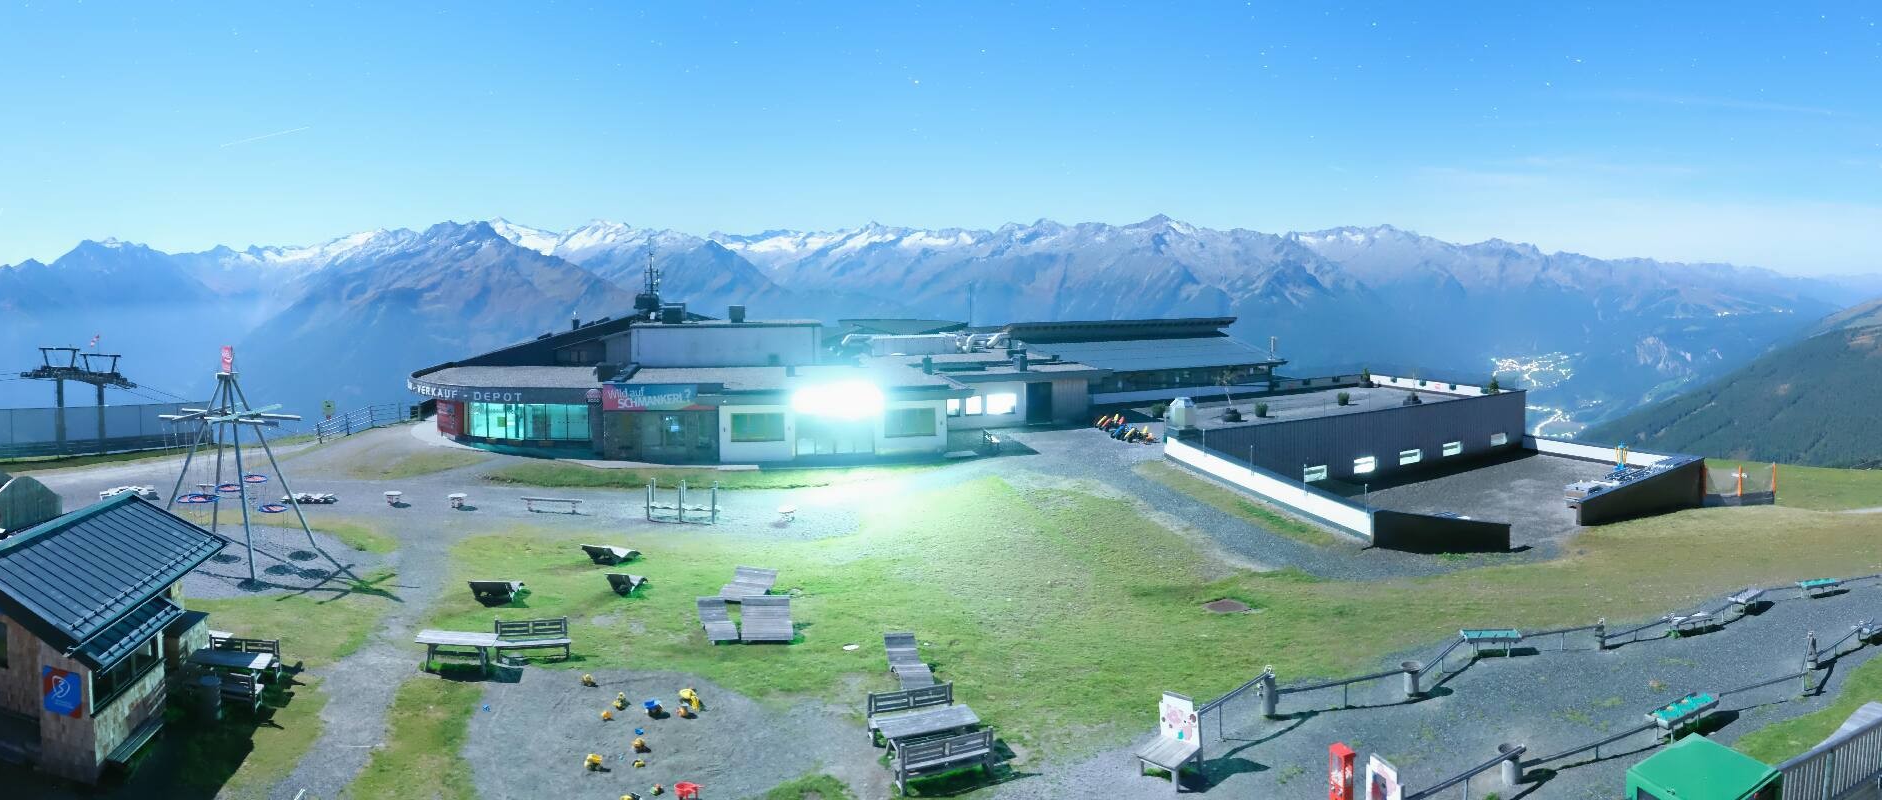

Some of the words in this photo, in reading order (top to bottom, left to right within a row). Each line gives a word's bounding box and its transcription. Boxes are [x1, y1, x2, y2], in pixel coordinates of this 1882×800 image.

[417, 385, 457, 399] VERKAUF
[473, 391, 522, 402] DEPOT
[608, 388, 628, 399] Wild
[630, 386, 645, 397] auf
